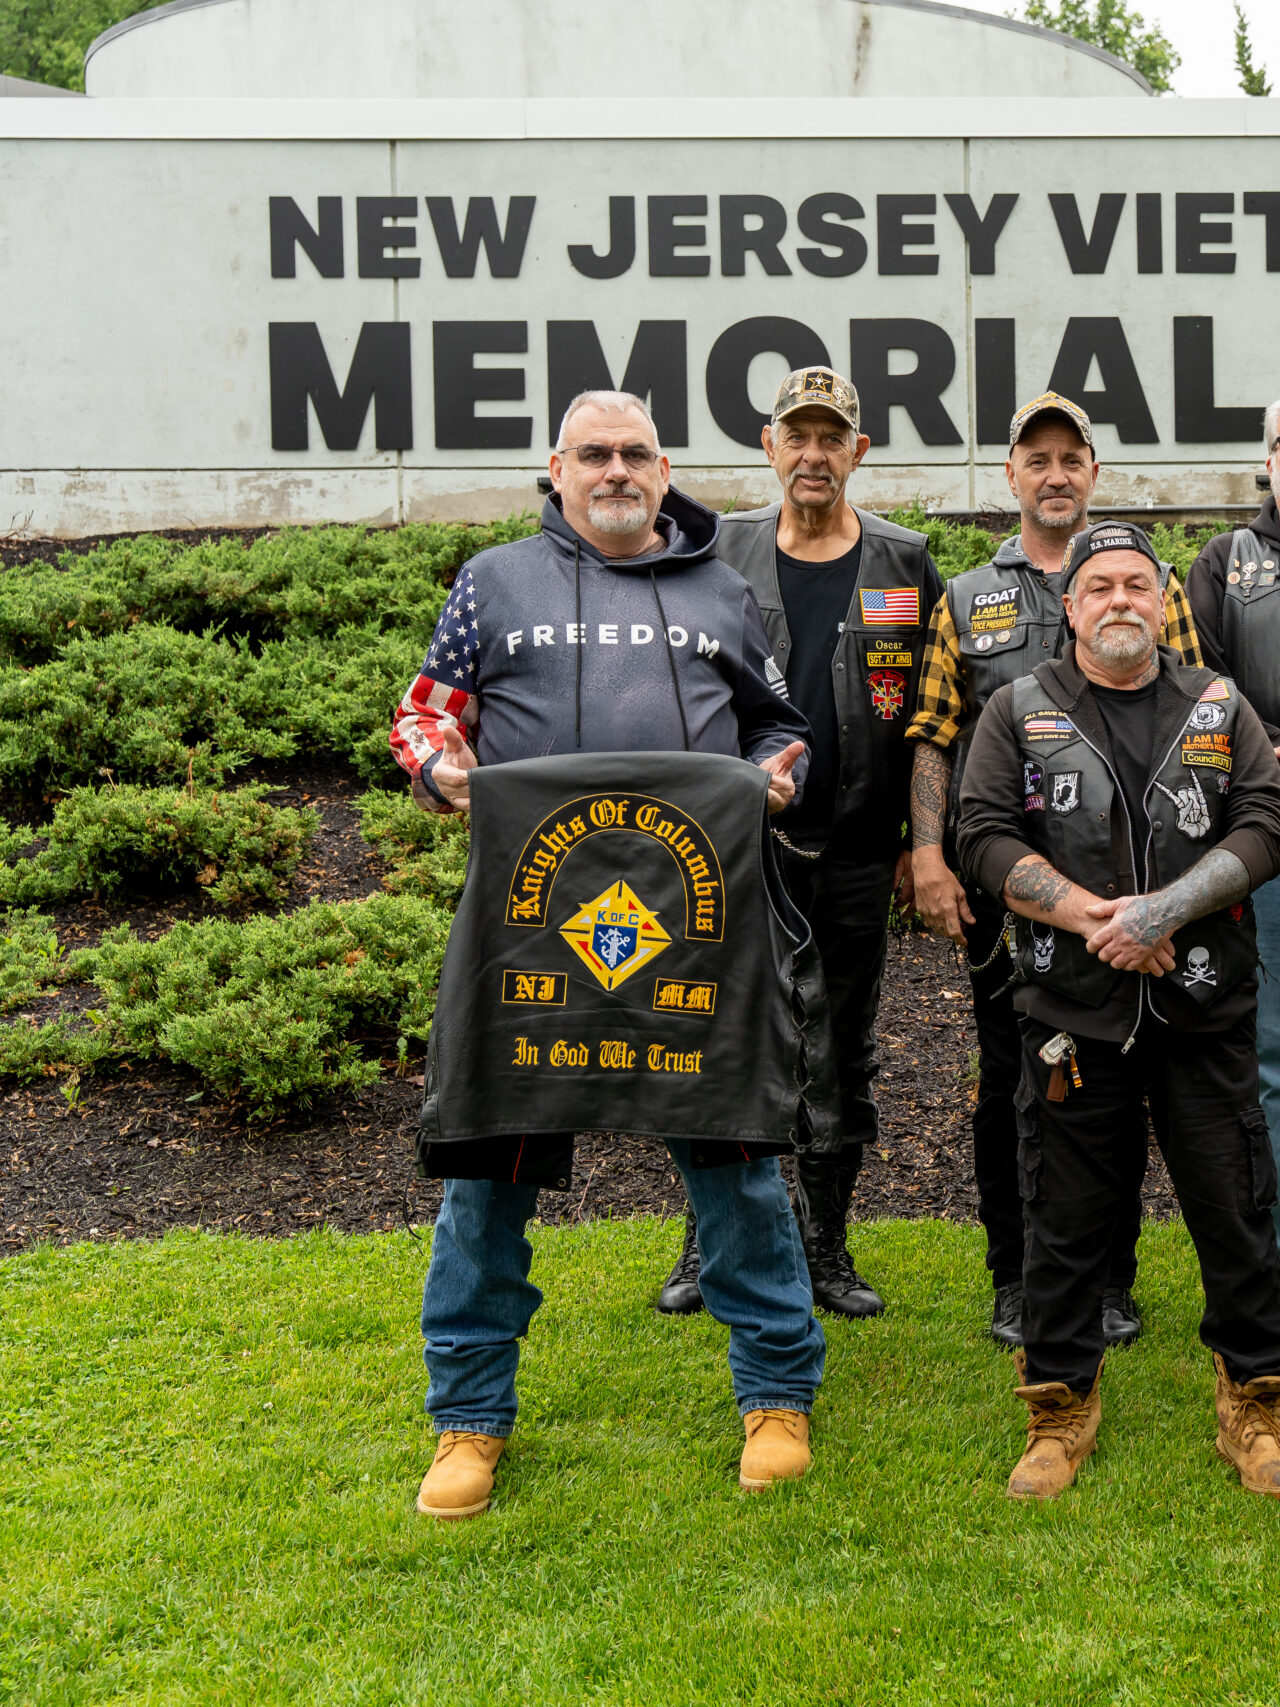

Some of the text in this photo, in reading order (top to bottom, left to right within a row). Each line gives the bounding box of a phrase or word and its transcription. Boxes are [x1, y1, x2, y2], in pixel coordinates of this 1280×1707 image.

[269, 195, 536, 279] NEW
[567, 191, 1020, 278] JERSEY
[268, 315, 1265, 452] MEMORIAL
[1090, 538, 1132, 550] U.S. MARINE
[975, 587, 1019, 605] GOAT
[982, 606, 998, 615] AM
[1000, 602, 1015, 611] MY
[973, 618, 1014, 630] VICE PRESIDENT
[507, 623, 720, 660] FREEDOM
[875, 639, 903, 650] Oscar
[870, 655, 910, 664] SGT. AT ARMS
[1024, 712, 1037, 721] ALL
[1186, 733, 1230, 745] I AM MY
[1214, 743, 1232, 754] KEEPER
[512, 799, 720, 933] Knights Of Columbus
[597, 910, 639, 926] K OF C
[511, 1037, 703, 1074] In God We Trust
